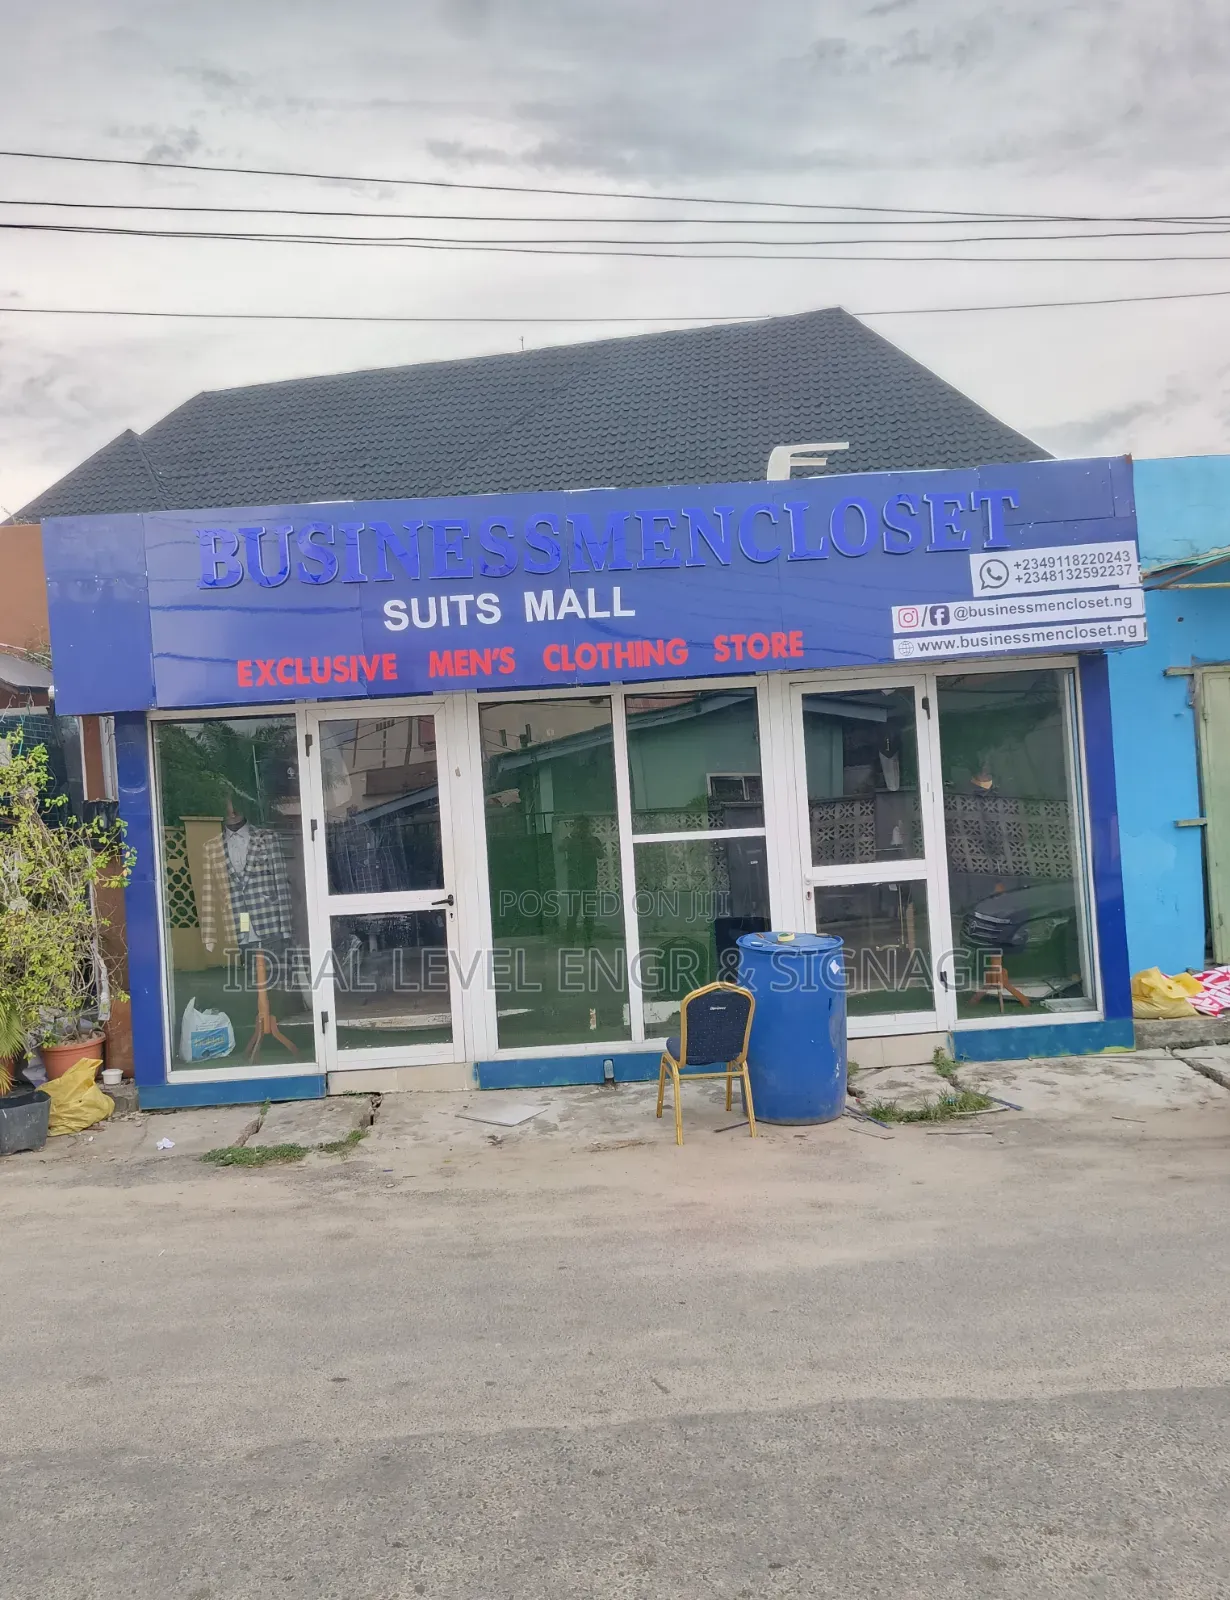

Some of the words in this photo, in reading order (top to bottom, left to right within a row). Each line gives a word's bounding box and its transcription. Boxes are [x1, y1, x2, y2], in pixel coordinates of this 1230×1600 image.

[196, 489, 1019, 589] BUSINESSMENCLOSET
[1013, 550, 1131, 571] +2349118220243
[1015, 563, 1132, 584] +2348132592237
[383, 592, 501, 631] SUITS
[524, 586, 636, 622] MALL
[953, 595, 1132, 621] @businessmencloset.ng
[917, 622, 1137, 652] www.businessmencloset.ng
[237, 653, 398, 687] EXCLUSIVE
[429, 647, 516, 678] MEN'S
[543, 638, 688, 672] CLOTHING
[714, 631, 804, 662] STORE
